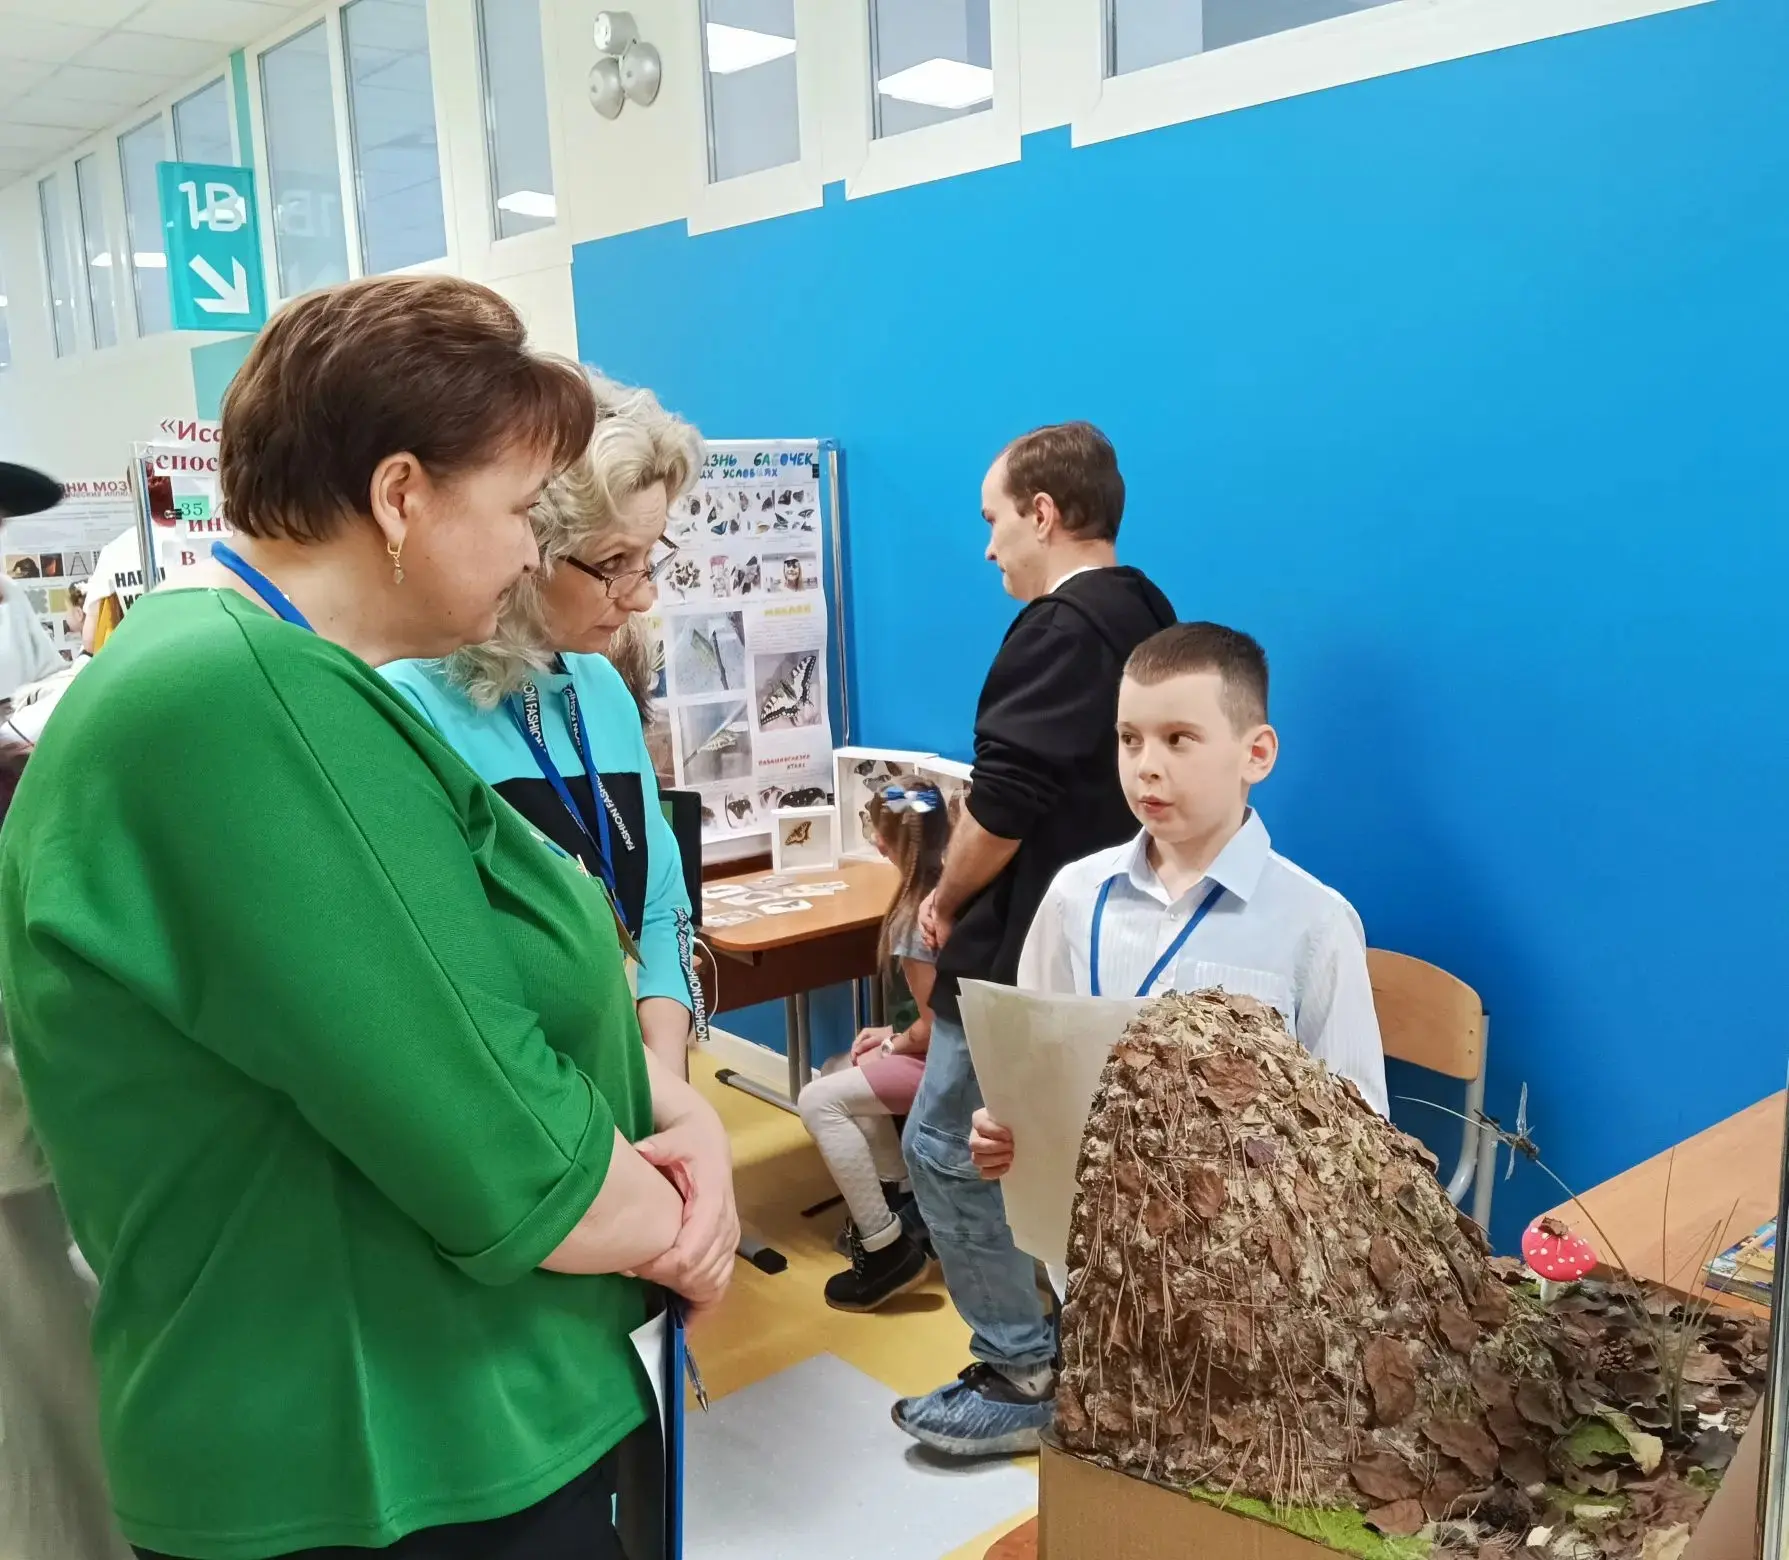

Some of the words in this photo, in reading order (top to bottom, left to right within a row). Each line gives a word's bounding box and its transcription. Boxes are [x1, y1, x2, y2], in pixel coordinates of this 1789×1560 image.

[181, 502, 203, 516] 35
[610, 807, 636, 852] FASHION
[693, 998, 708, 1042] FASHION
